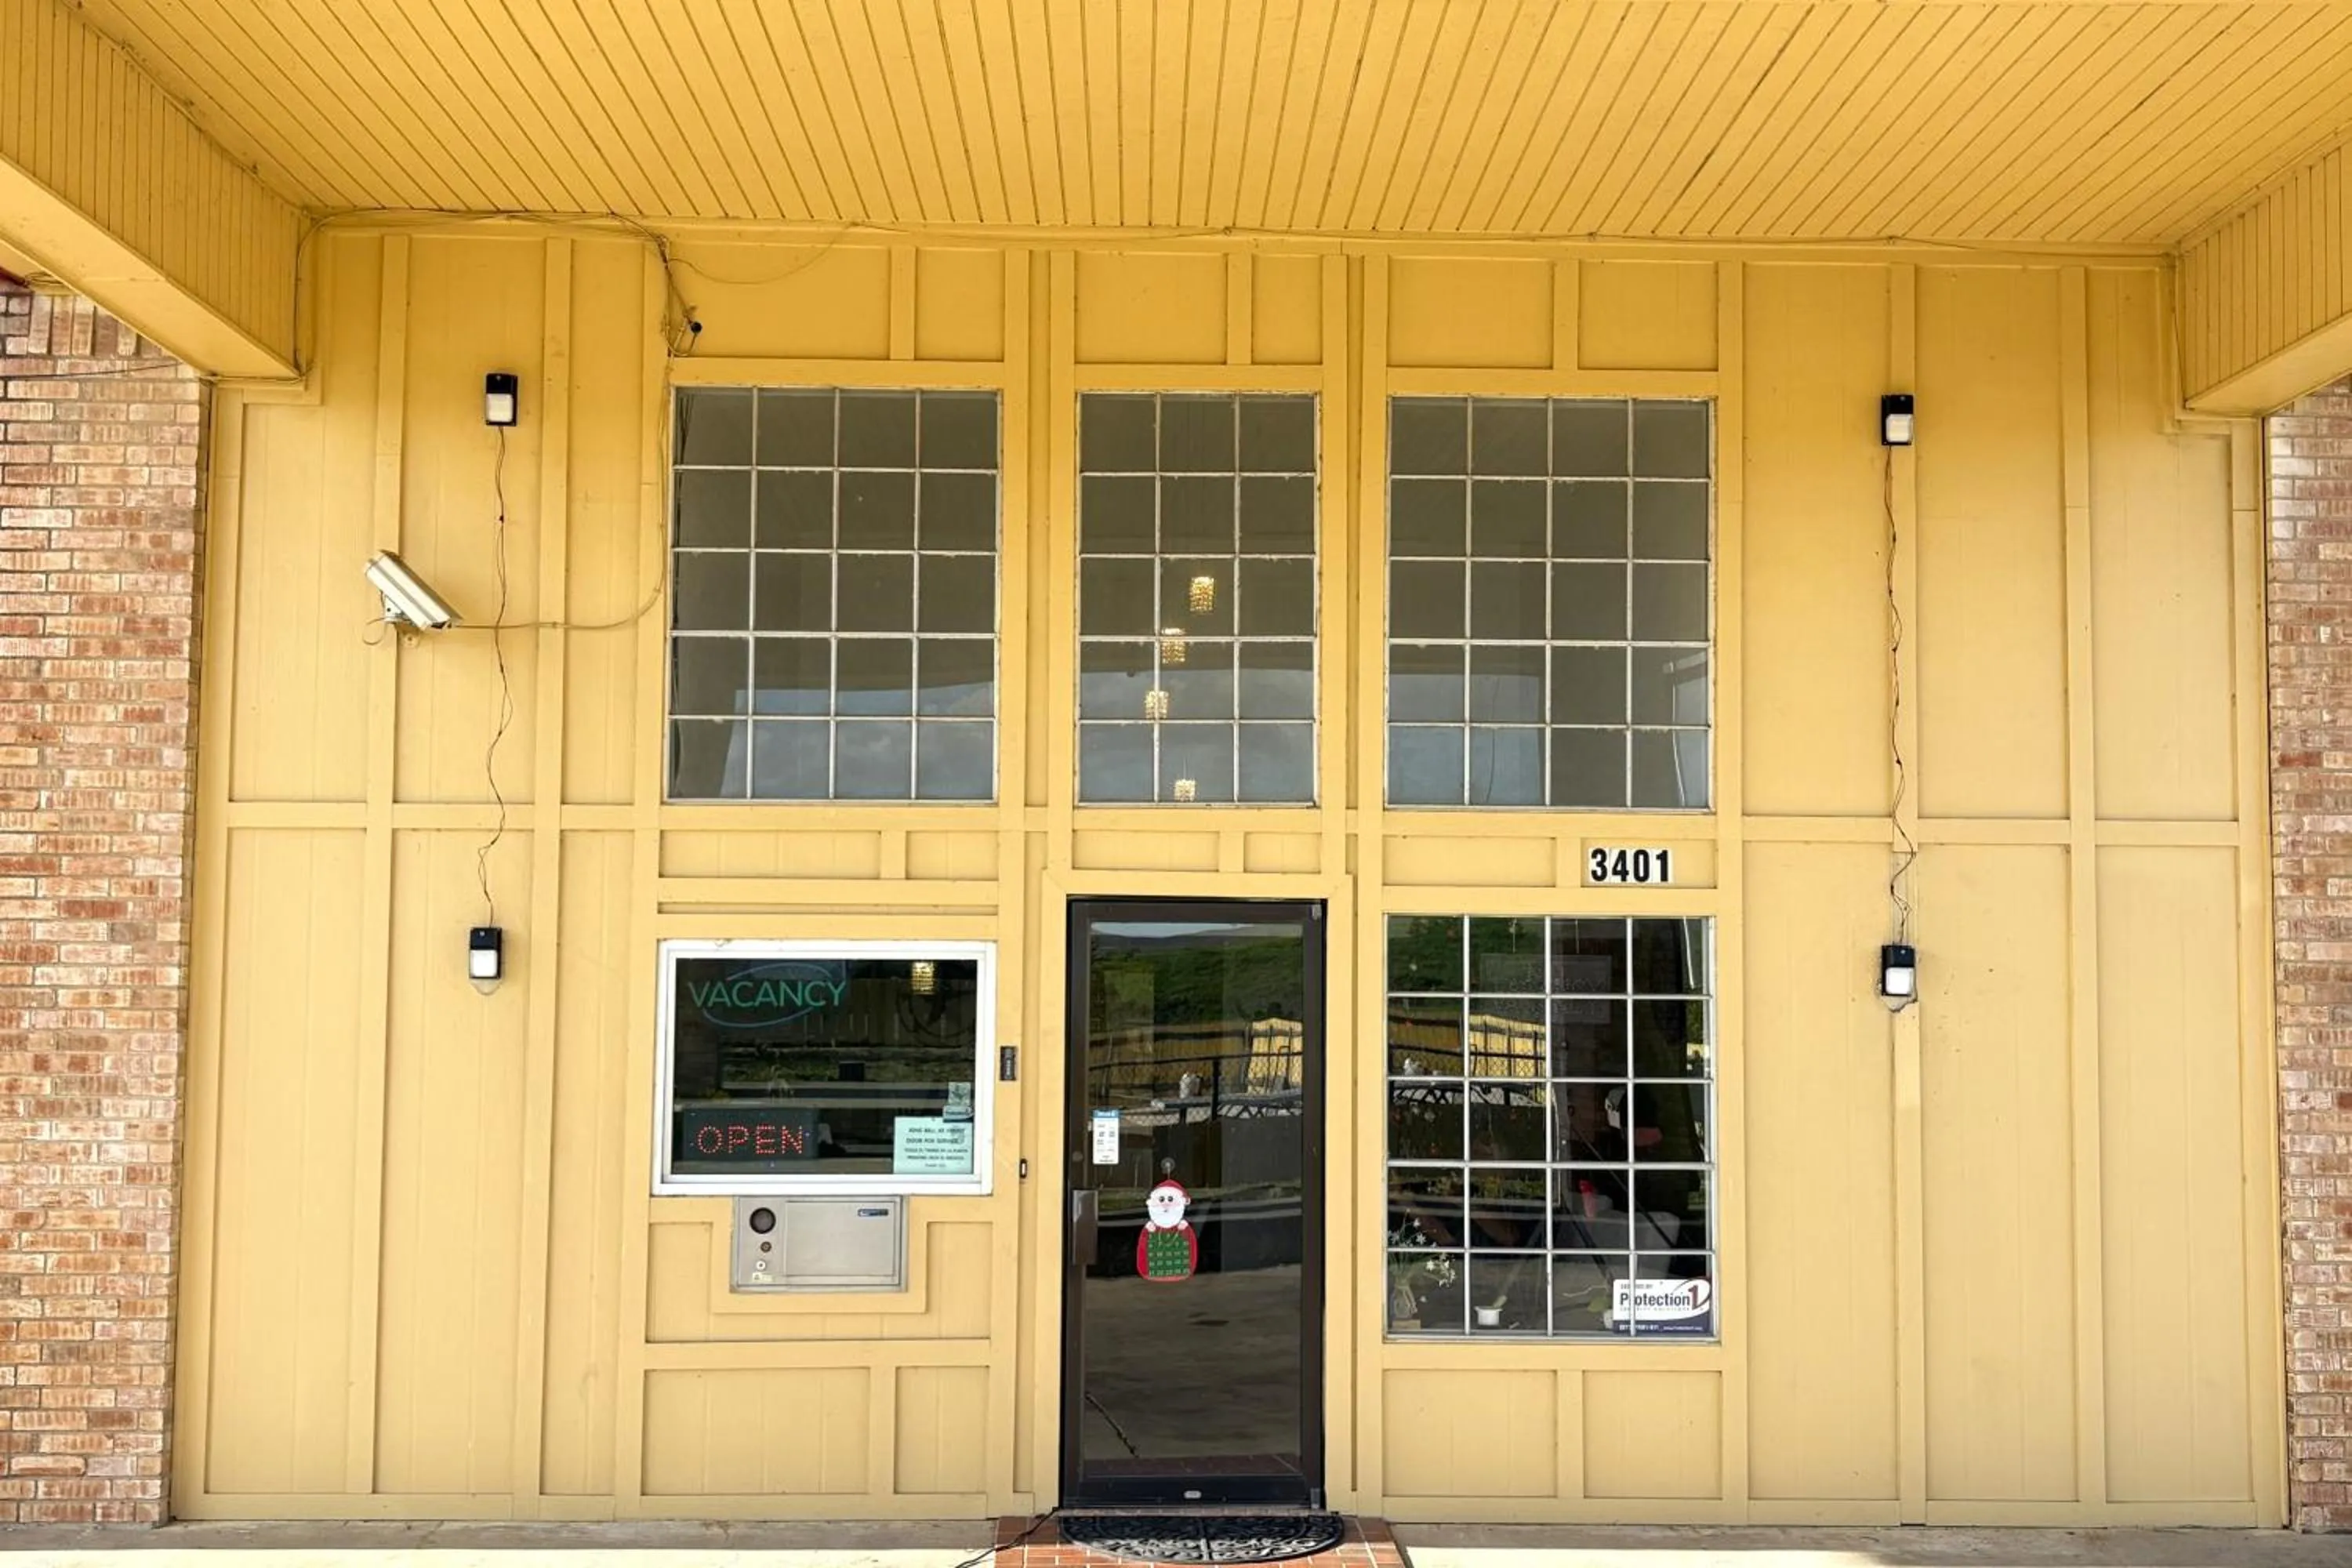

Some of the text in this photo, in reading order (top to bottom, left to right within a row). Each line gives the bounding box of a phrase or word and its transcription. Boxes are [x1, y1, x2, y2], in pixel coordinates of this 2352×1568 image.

[1591, 848, 1668, 882] 3401
[688, 980, 847, 1007] VACANCY
[697, 1125, 803, 1154] OPEN
[1620, 1292, 1690, 1307] Potection
